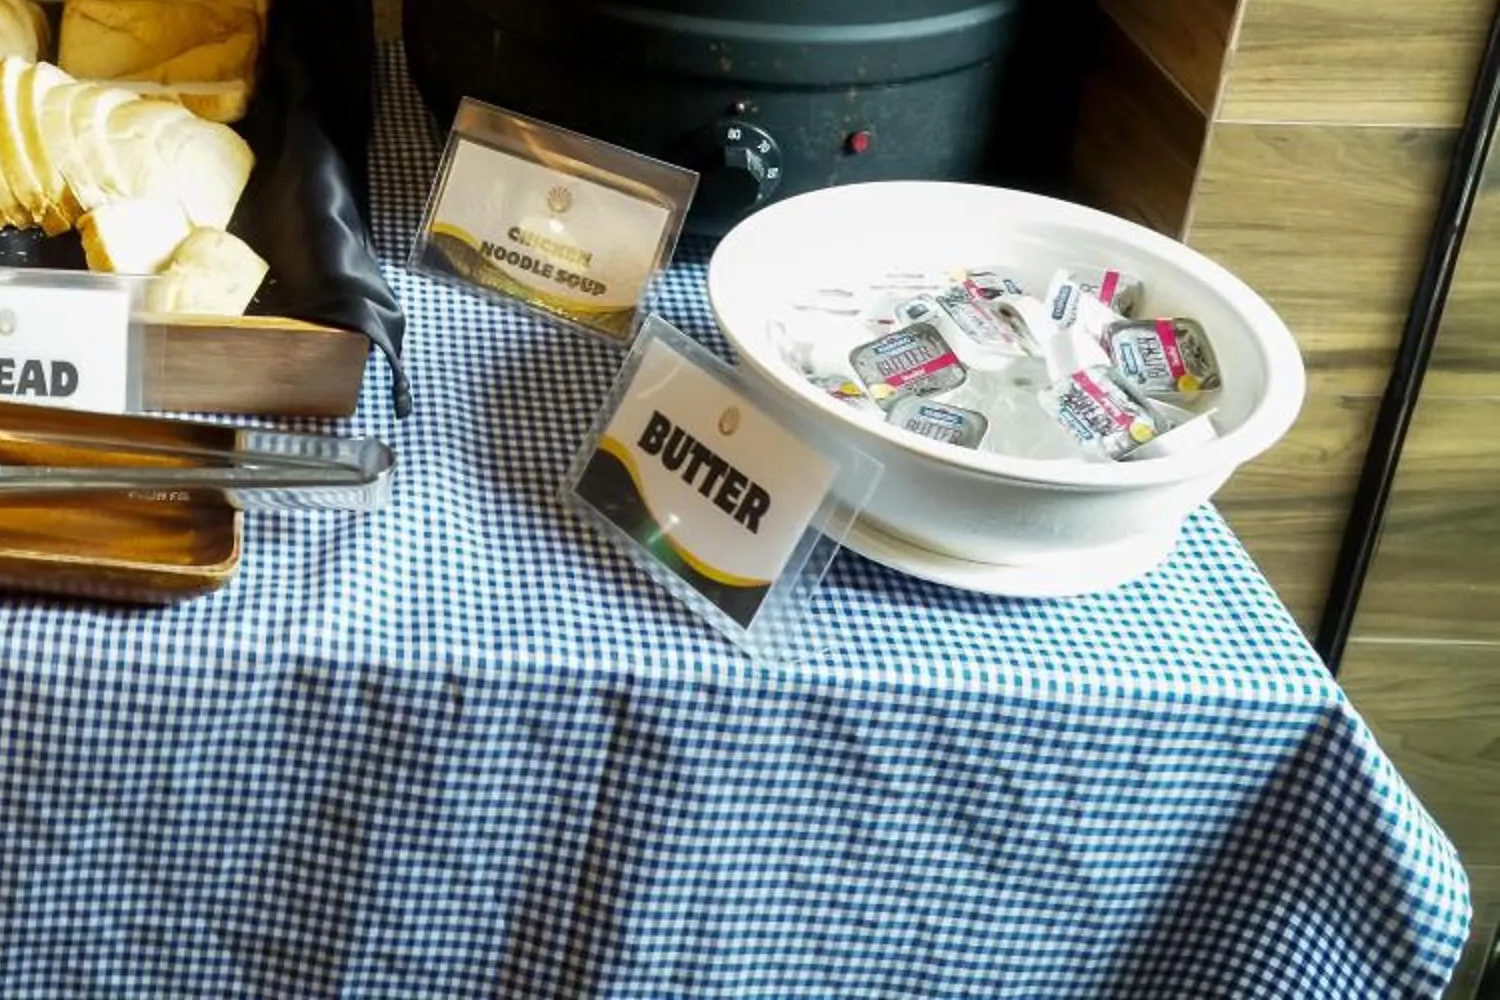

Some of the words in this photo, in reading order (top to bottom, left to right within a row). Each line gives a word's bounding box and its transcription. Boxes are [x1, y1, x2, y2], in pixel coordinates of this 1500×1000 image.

[479, 241, 554, 280] NOODLE
[553, 269, 607, 297] SOUP
[637, 409, 771, 535] BUTTER
